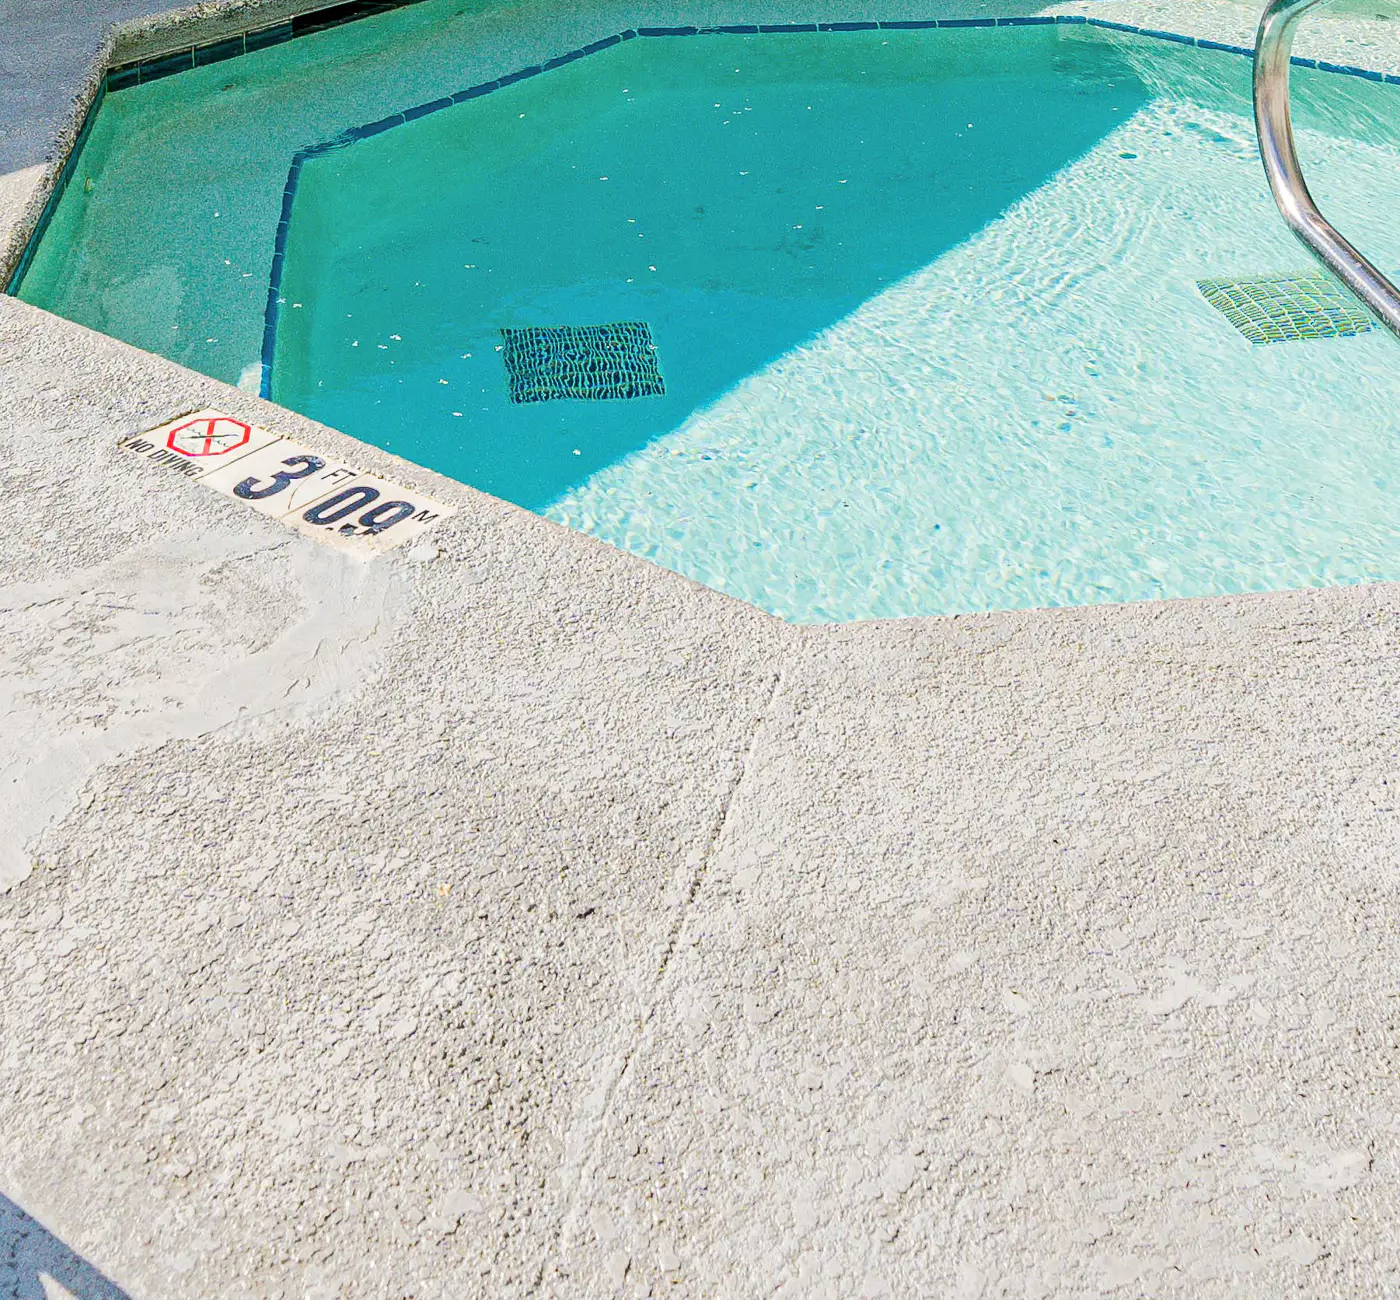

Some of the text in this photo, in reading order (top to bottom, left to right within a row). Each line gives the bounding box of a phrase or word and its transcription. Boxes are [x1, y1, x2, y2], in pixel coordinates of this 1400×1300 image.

[125, 439, 204, 476] NO DIVING
[233, 455, 356, 499] 3 FT
[412, 510, 439, 524] M
